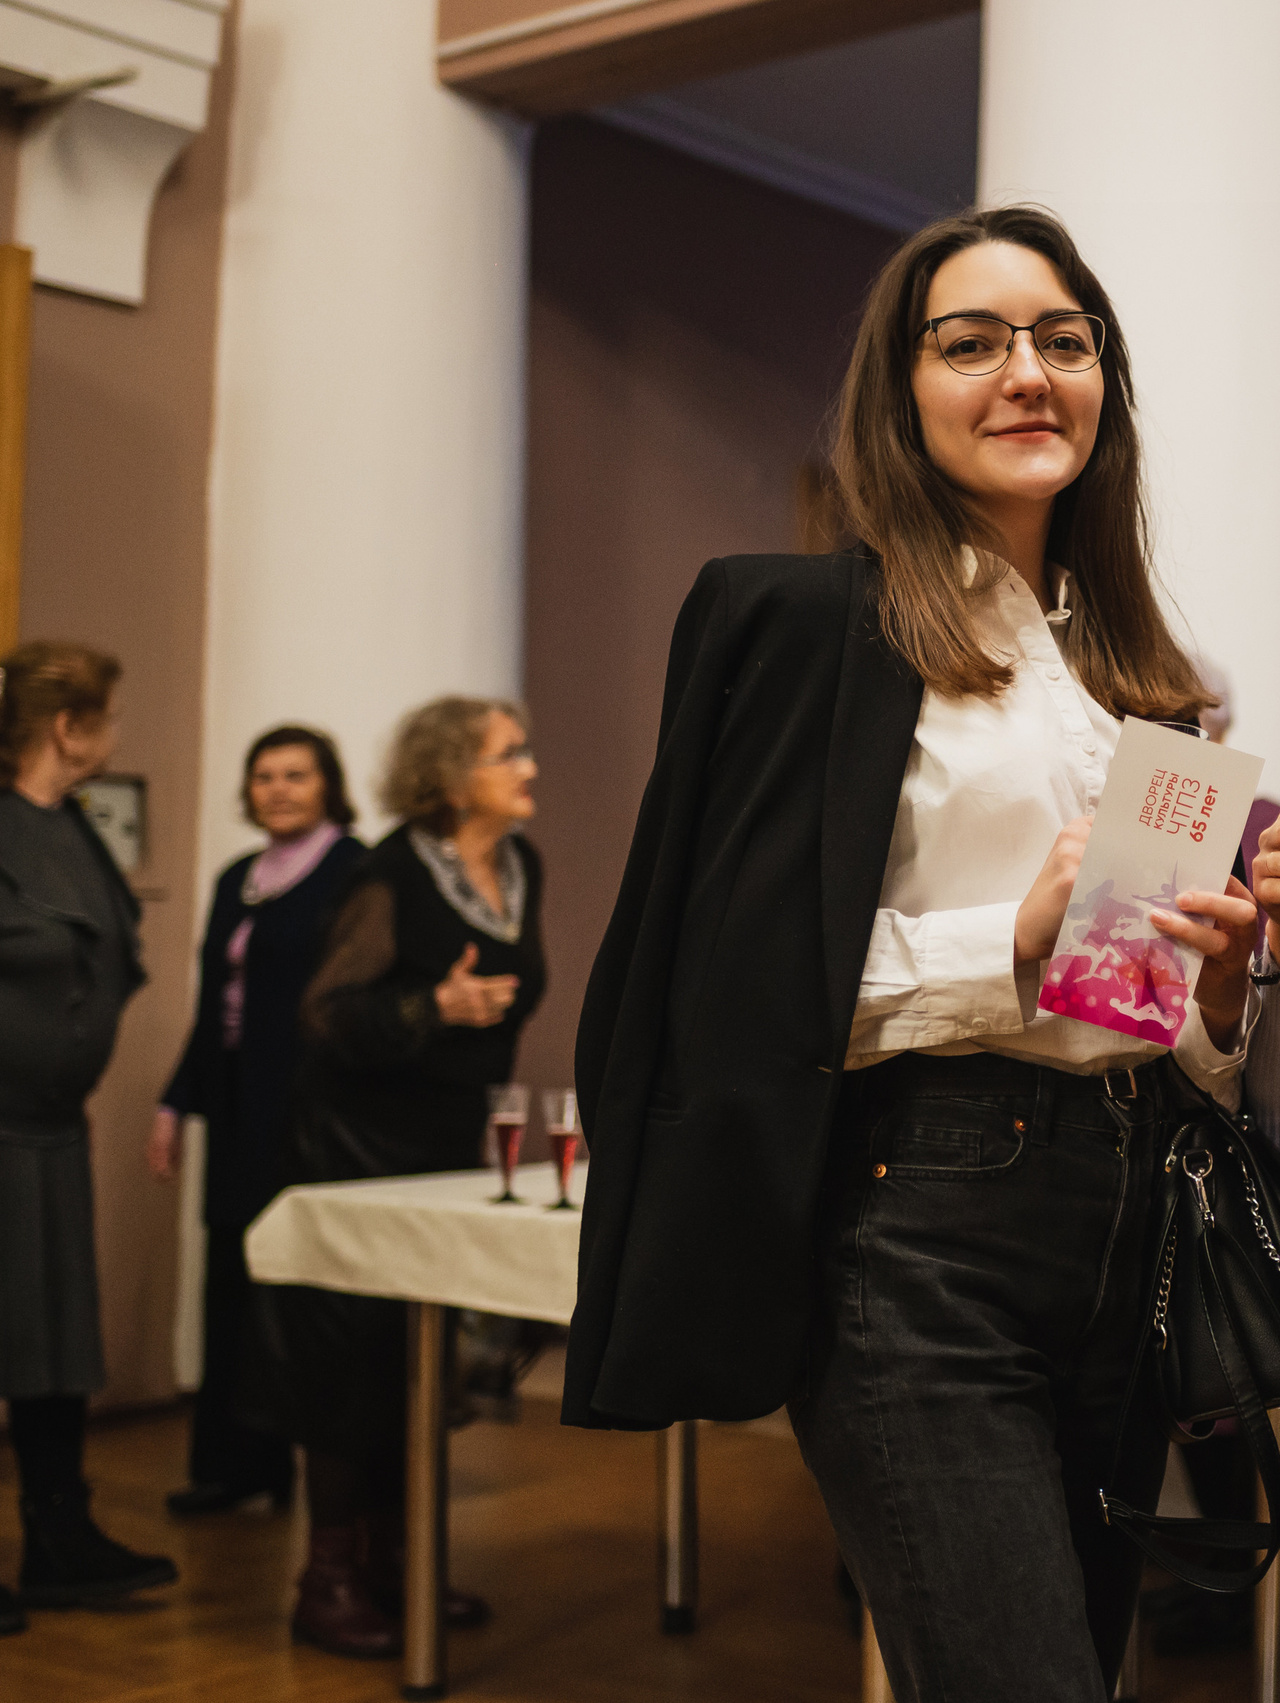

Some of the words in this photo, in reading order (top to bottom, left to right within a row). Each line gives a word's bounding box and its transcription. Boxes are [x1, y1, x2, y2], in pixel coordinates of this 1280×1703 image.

[1138, 768, 1168, 827] ДВОРЕЦ
[1153, 772, 1180, 830] КУЛЬТУРЫ
[1166, 778, 1201, 835] ЧТПЗ
[1189, 819, 1207, 843] 65
[1200, 785, 1219, 818] лет
